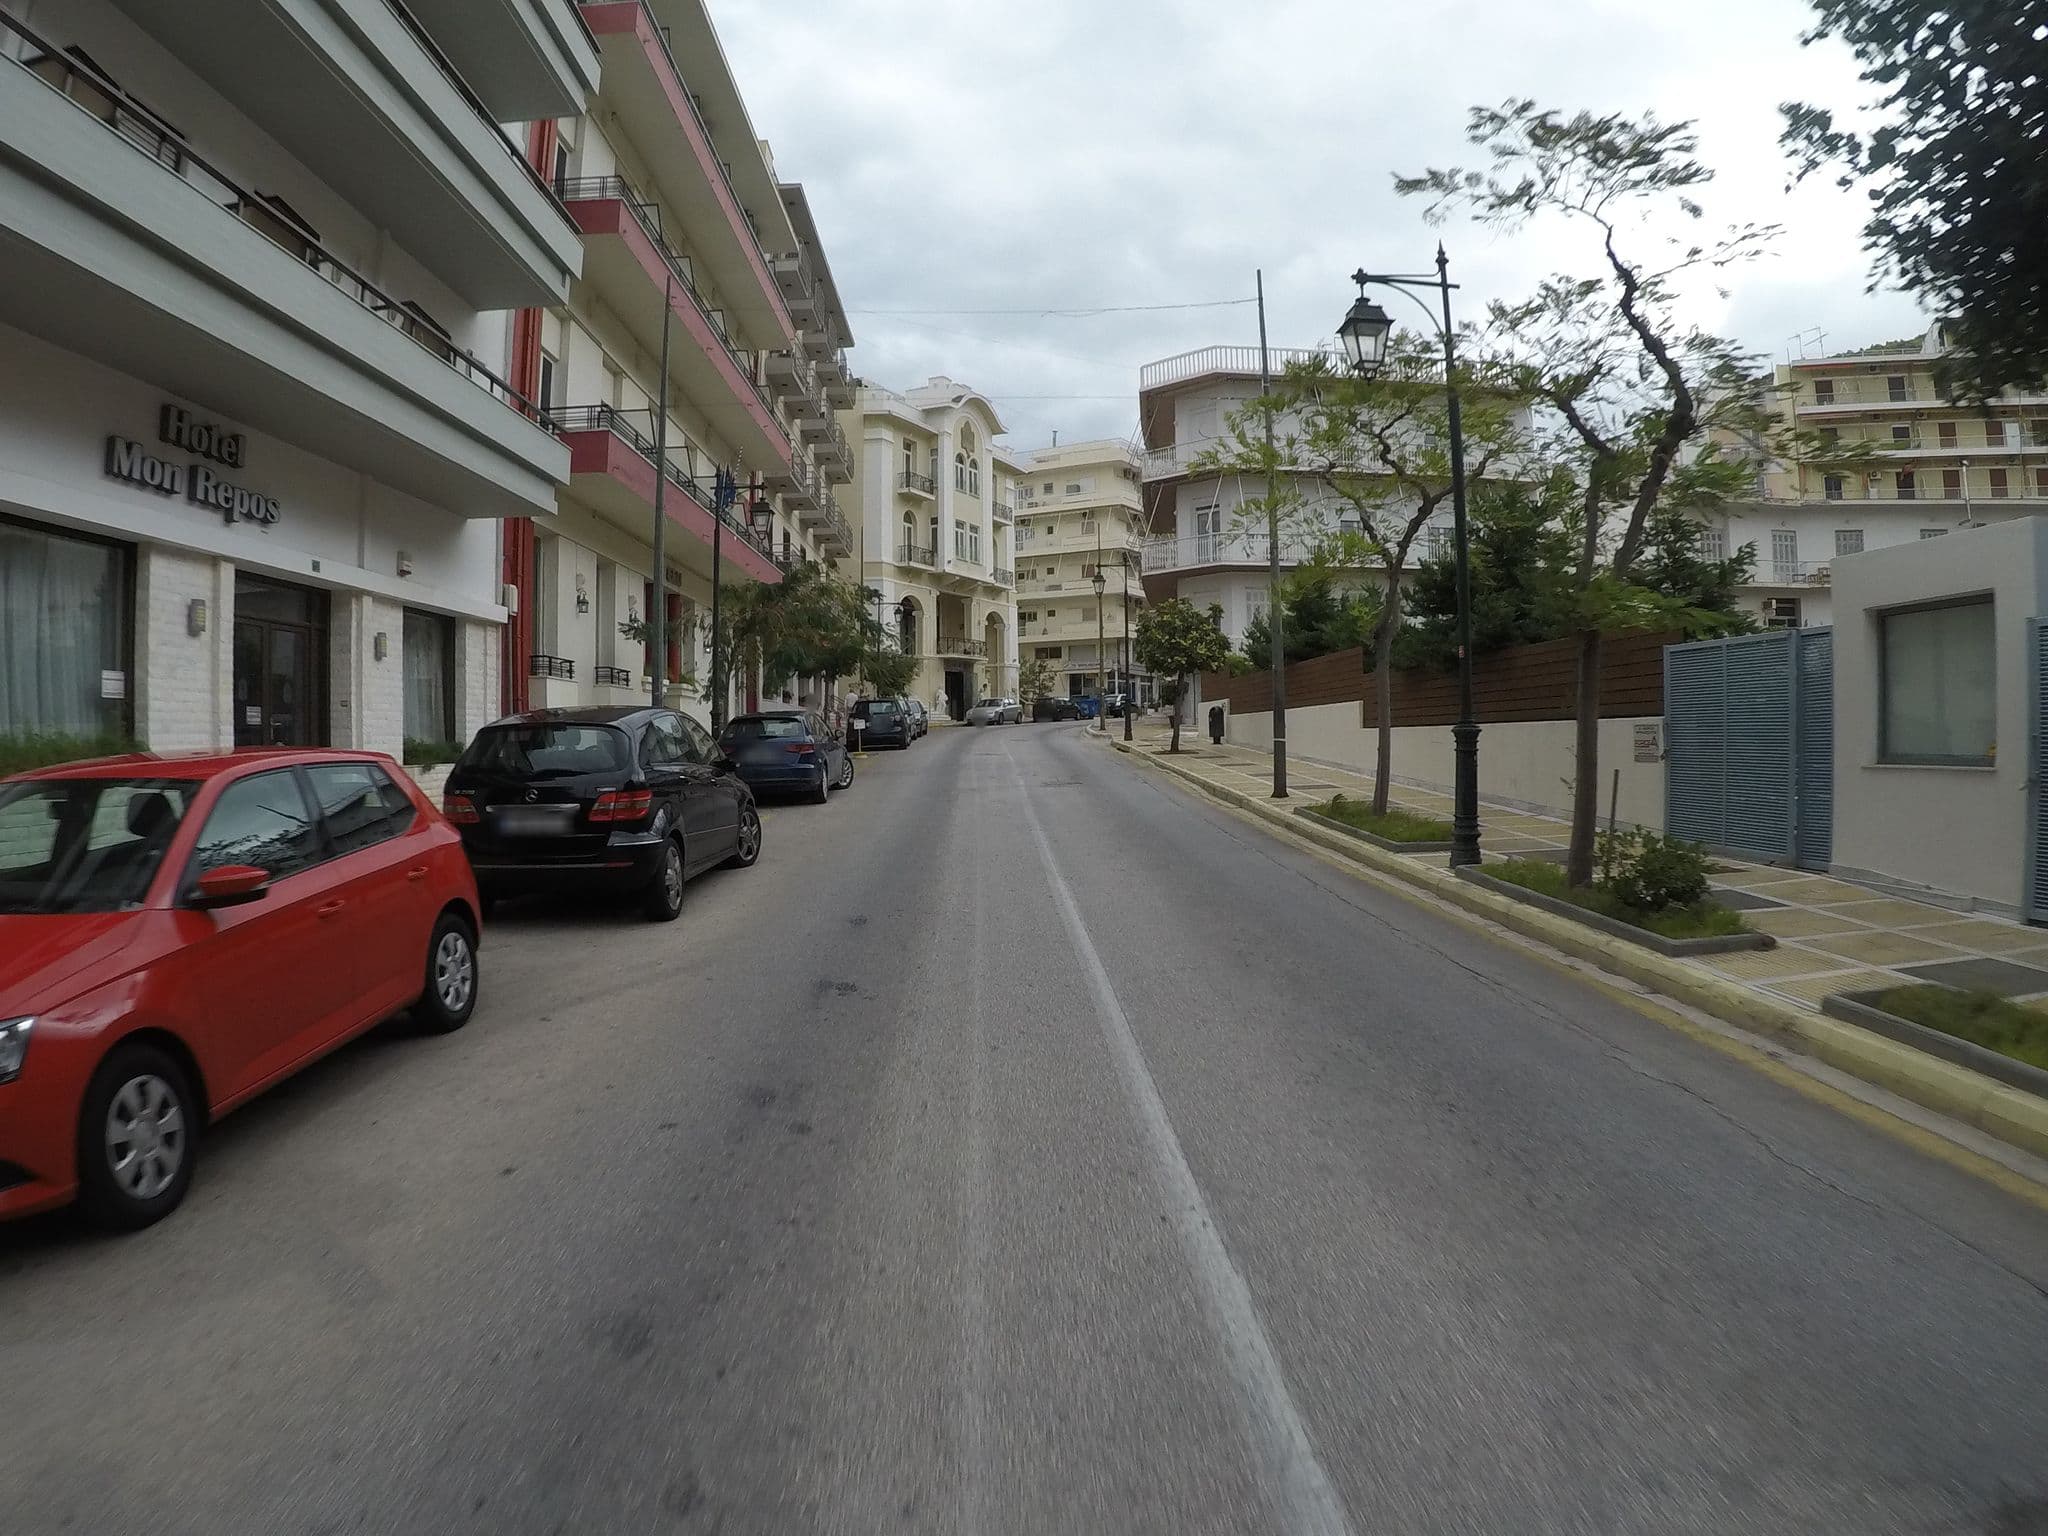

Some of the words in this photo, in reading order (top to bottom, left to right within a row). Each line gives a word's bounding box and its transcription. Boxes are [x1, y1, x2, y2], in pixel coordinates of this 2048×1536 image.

[162, 404, 246, 467] Hotel
[108, 436, 184, 493] Mon
[190, 464, 281, 522] Repos
